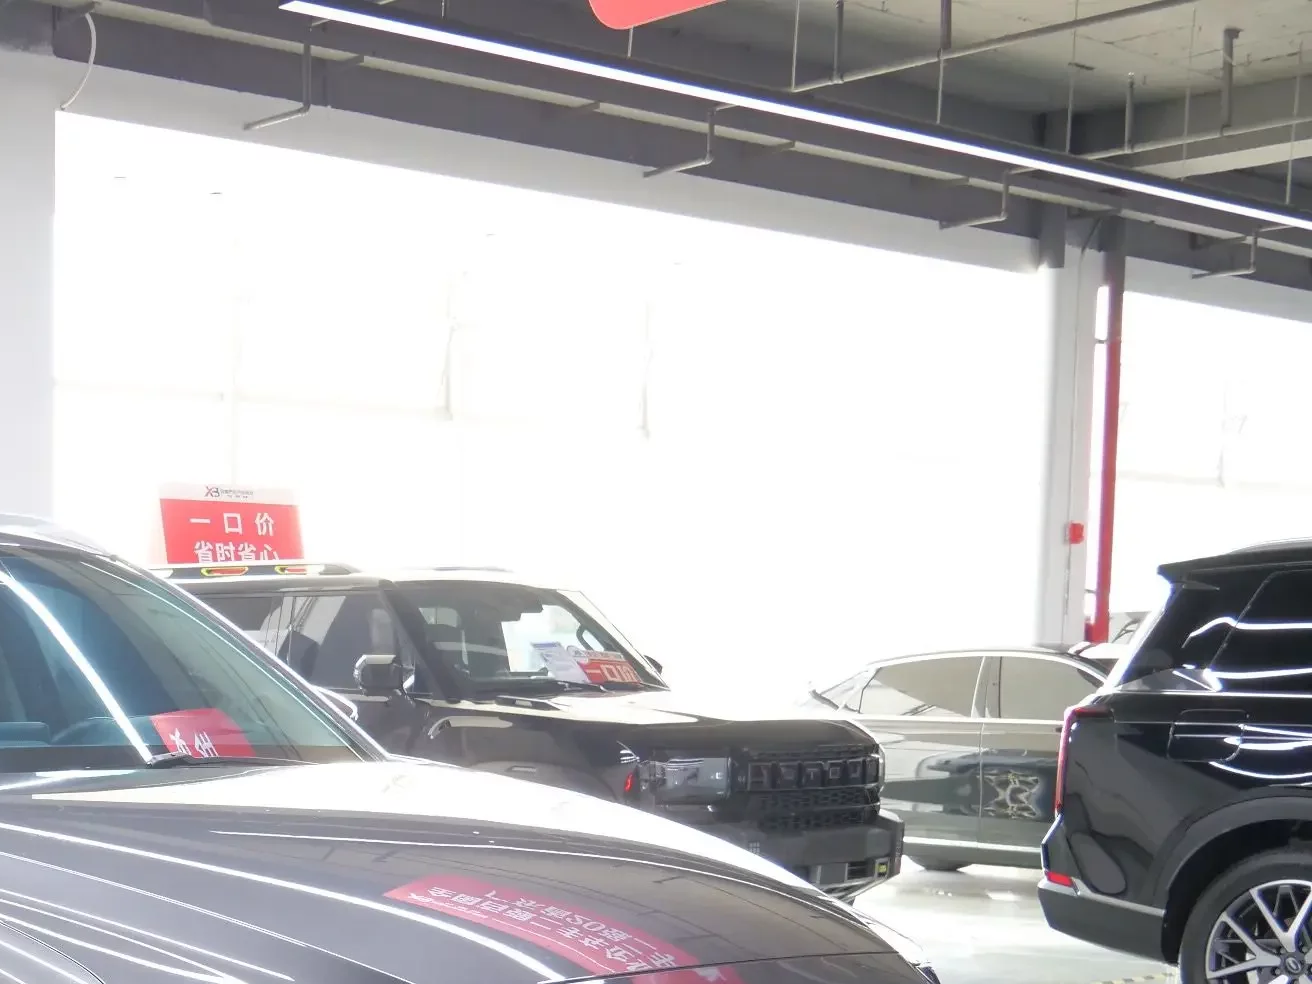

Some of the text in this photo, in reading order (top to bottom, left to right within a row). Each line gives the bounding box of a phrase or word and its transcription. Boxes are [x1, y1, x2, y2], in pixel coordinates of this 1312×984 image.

[190, 512, 276, 537] 一口价
[194, 541, 280, 564] 省时省心
